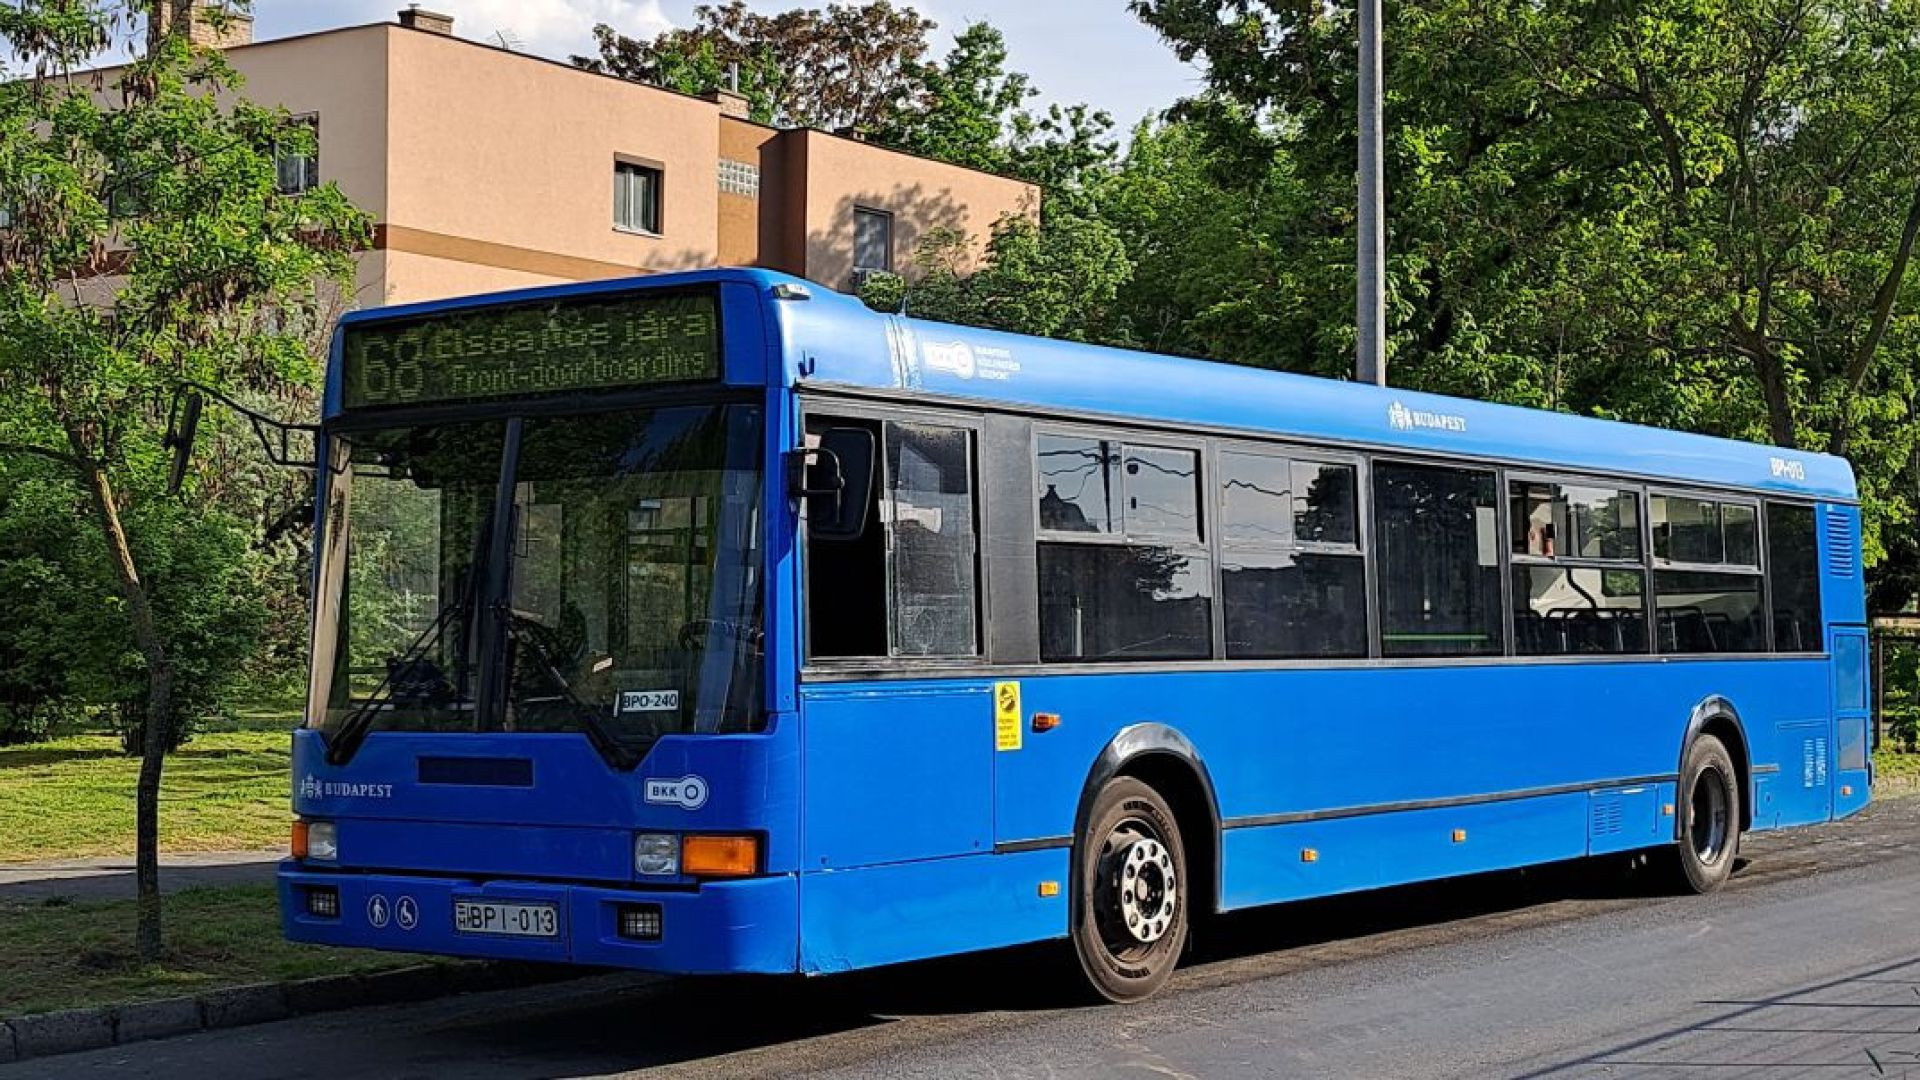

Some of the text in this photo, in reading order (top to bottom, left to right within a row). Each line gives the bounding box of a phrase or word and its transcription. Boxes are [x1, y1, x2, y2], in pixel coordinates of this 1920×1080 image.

[361, 334, 424, 401] 68
[452, 346, 706, 394] Front-door boarding
[1413, 411, 1467, 431] BUDAPEST
[1769, 457, 1805, 480] BPI-013
[623, 693, 678, 708] BPO-240
[325, 782, 393, 798] BUDAPEST
[652, 785, 677, 797] BKK
[470, 905, 555, 933] BPI-013
